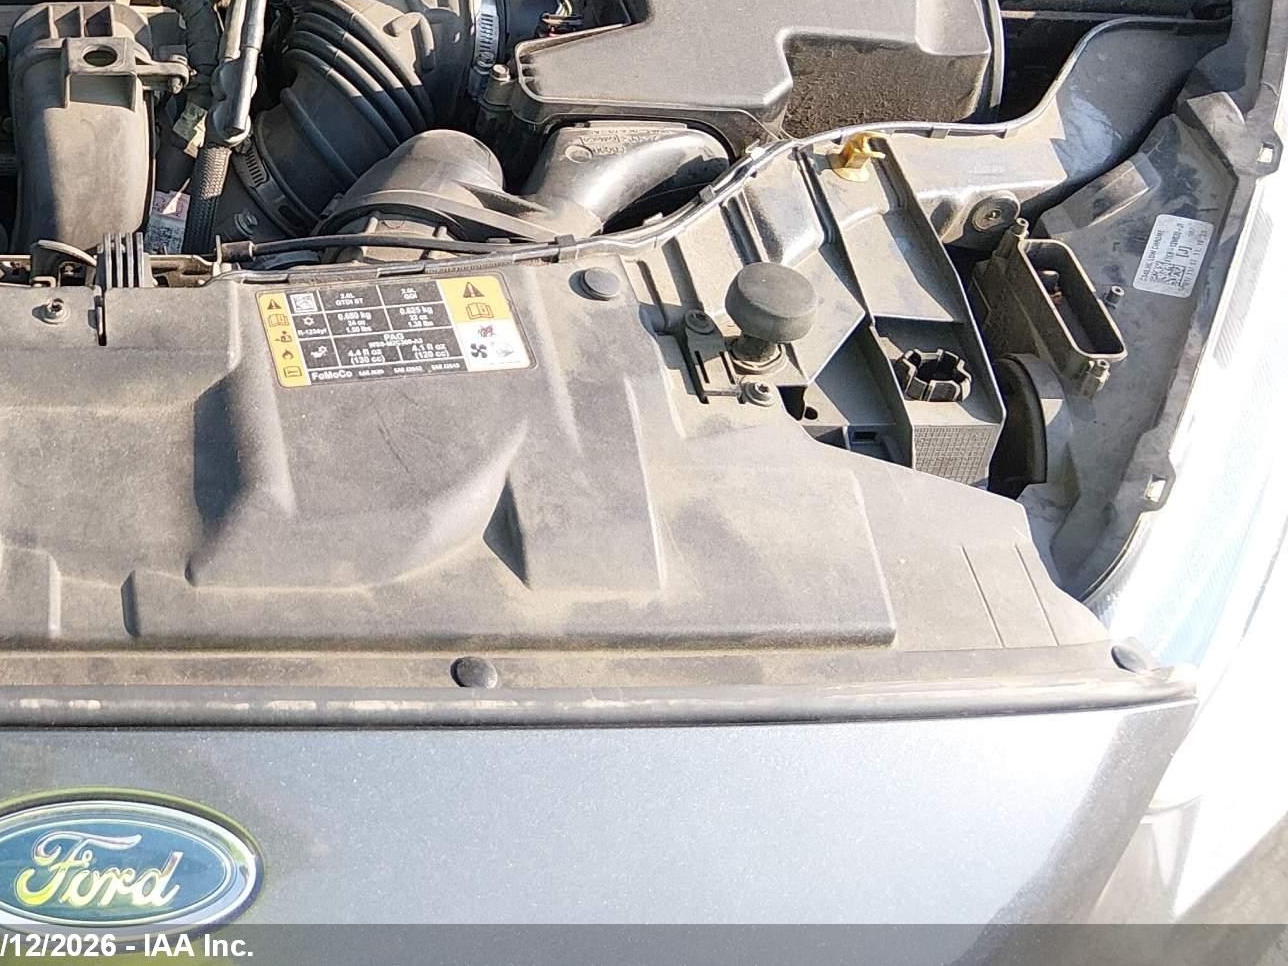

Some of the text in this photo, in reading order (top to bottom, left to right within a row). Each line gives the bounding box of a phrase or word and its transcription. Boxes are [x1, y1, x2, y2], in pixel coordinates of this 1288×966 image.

[422, 305, 433, 315] kg
[360, 311, 372, 320] kg
[383, 332, 405, 341] PAG
[412, 344, 425, 352] 4.1
[435, 343, 446, 351] oz
[311, 370, 353, 380] FoMoCo
[15, 831, 185, 908] Ford
